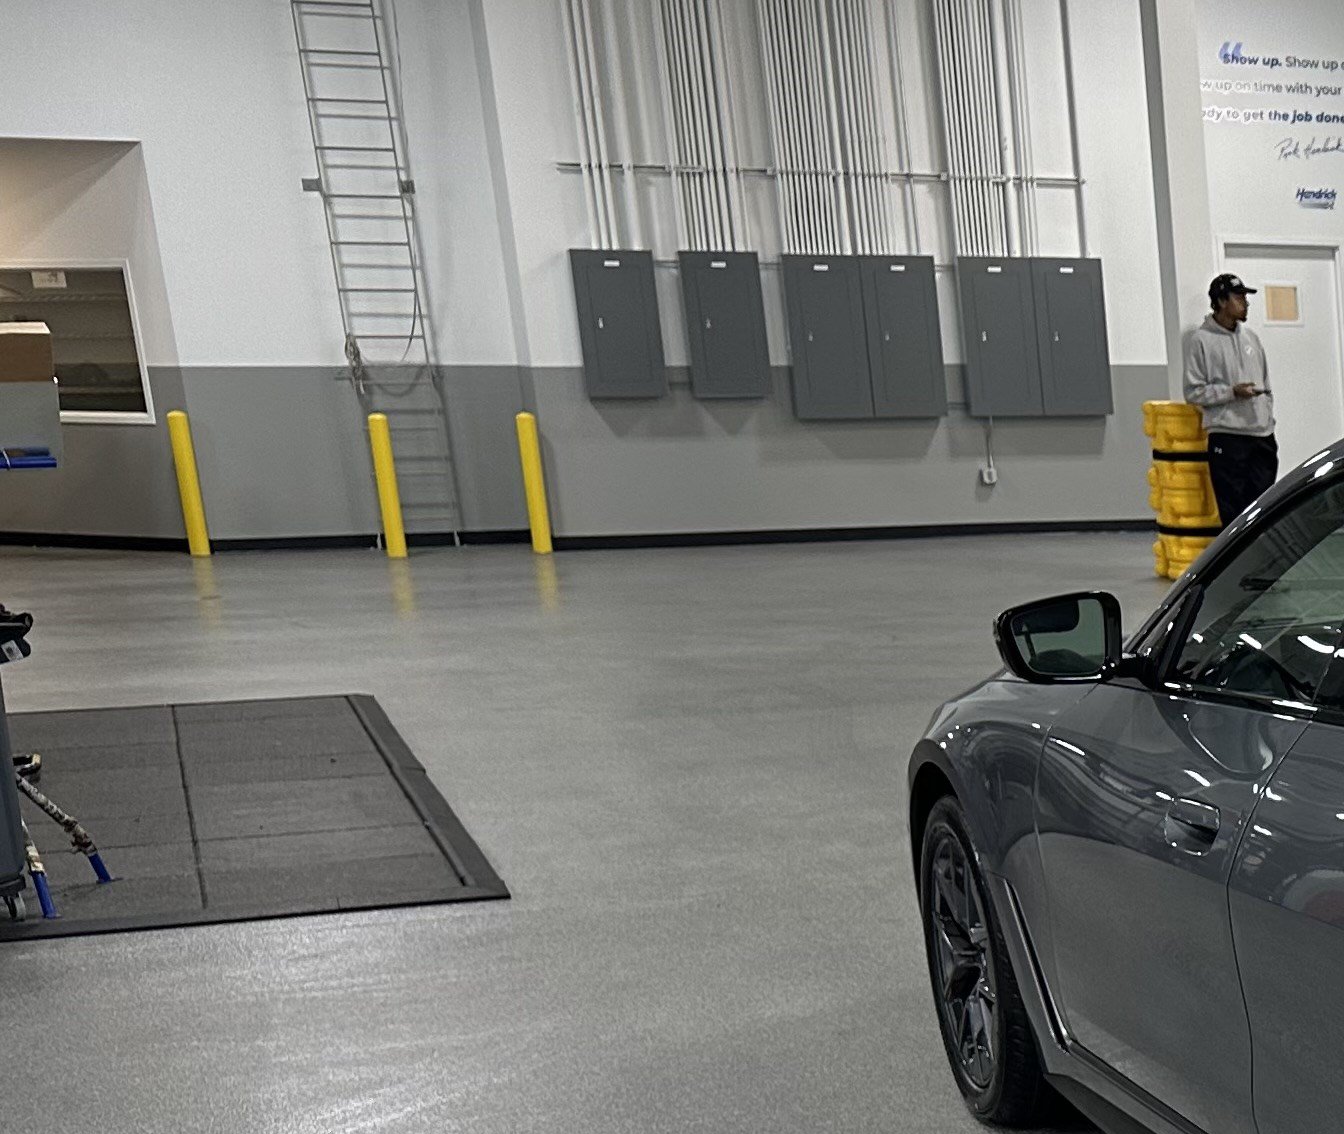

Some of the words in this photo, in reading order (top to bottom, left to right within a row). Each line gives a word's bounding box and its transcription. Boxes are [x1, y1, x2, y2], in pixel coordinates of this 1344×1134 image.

[1262, 58, 1282, 69] up.
[1285, 56, 1319, 68] Show
[1321, 59, 1338, 71] up
[1254, 80, 1283, 93] time
[1285, 81, 1313, 94] with
[1315, 85, 1342, 97] your
[1227, 109, 1239, 119] to
[1243, 110, 1264, 122] get
[1268, 110, 1290, 122] the
[1290, 110, 1313, 124] job
